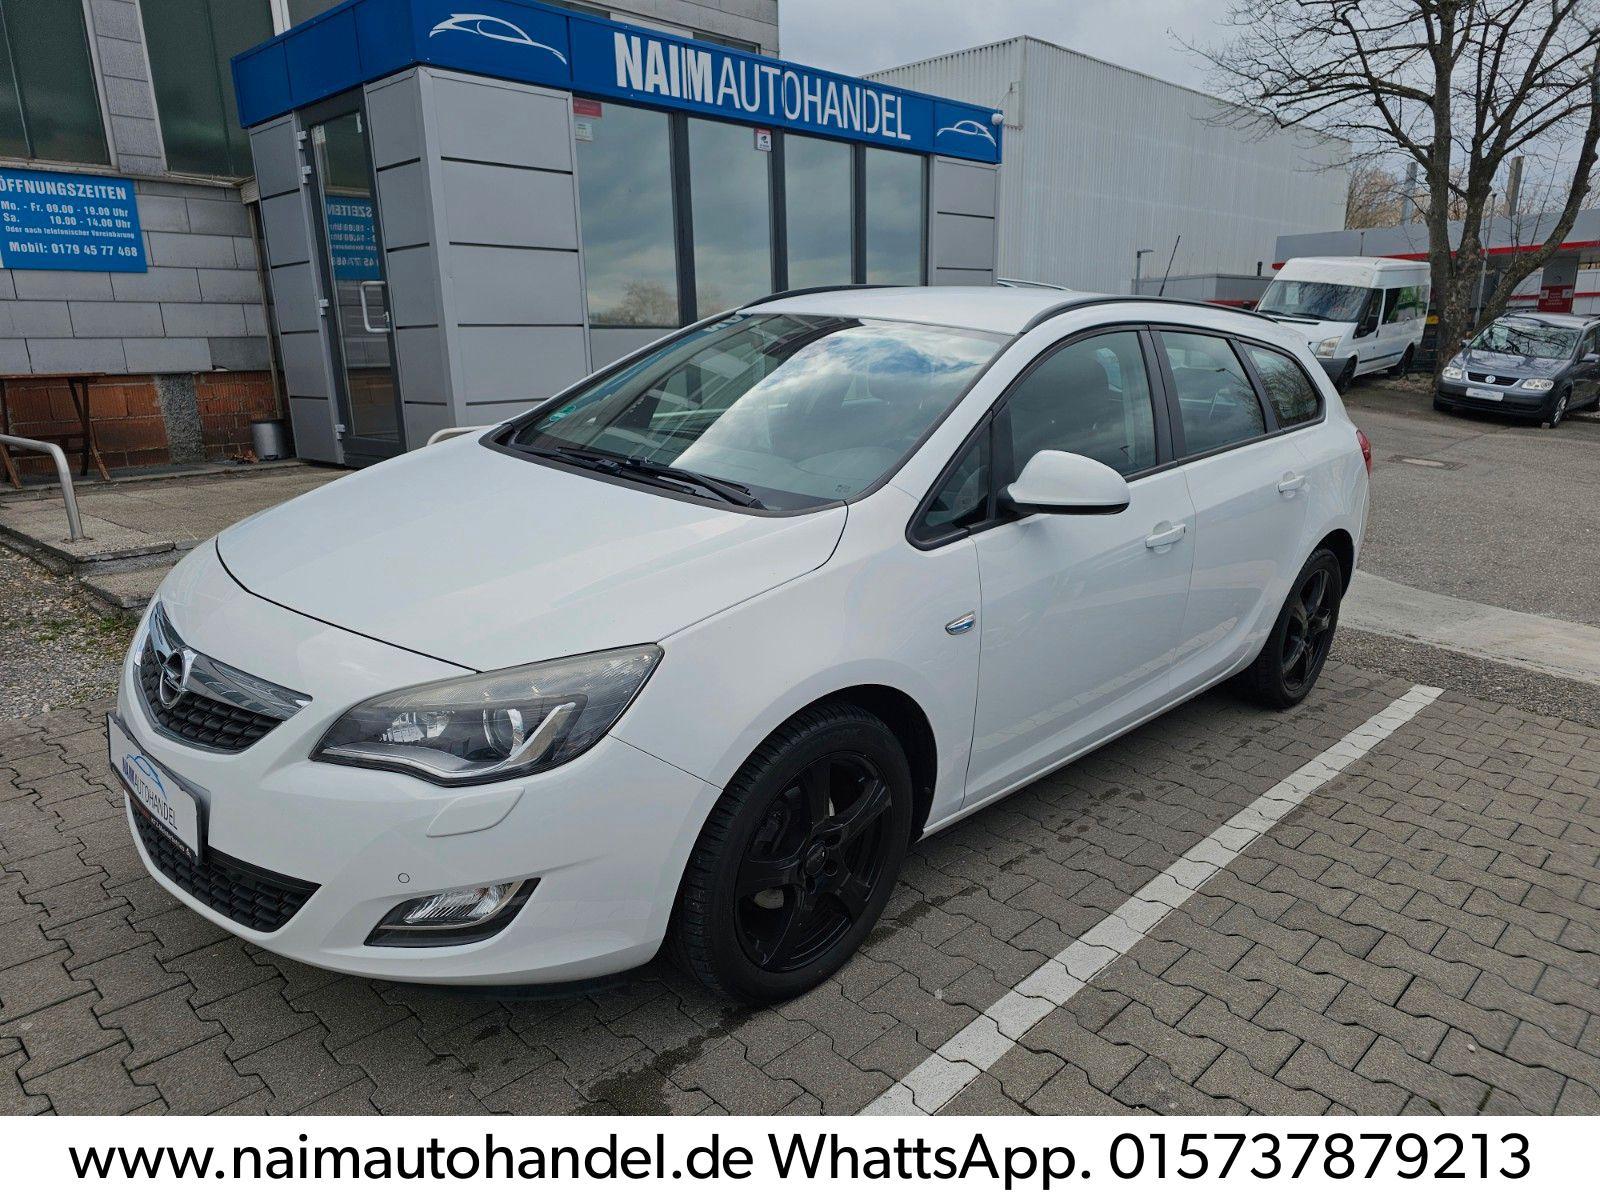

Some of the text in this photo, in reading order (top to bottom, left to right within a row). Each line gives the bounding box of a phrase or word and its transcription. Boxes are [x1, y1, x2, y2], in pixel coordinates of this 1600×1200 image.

[613, 31, 912, 141] NAIM AUTOHANDEL
[0, 175, 127, 200] ÖFFNUNGSZEITEN
[0, 200, 20, 211] Mo.
[30, 202, 44, 213] Fr.
[112, 207, 129, 218] Uhr
[2, 212, 20, 223] Sa.
[115, 218, 132, 229] Uhr
[9, 241, 48, 253] Mobil:
[51, 243, 80, 255] 0179
[83, 244, 98, 256] 45
[100, 245, 114, 256] 77
